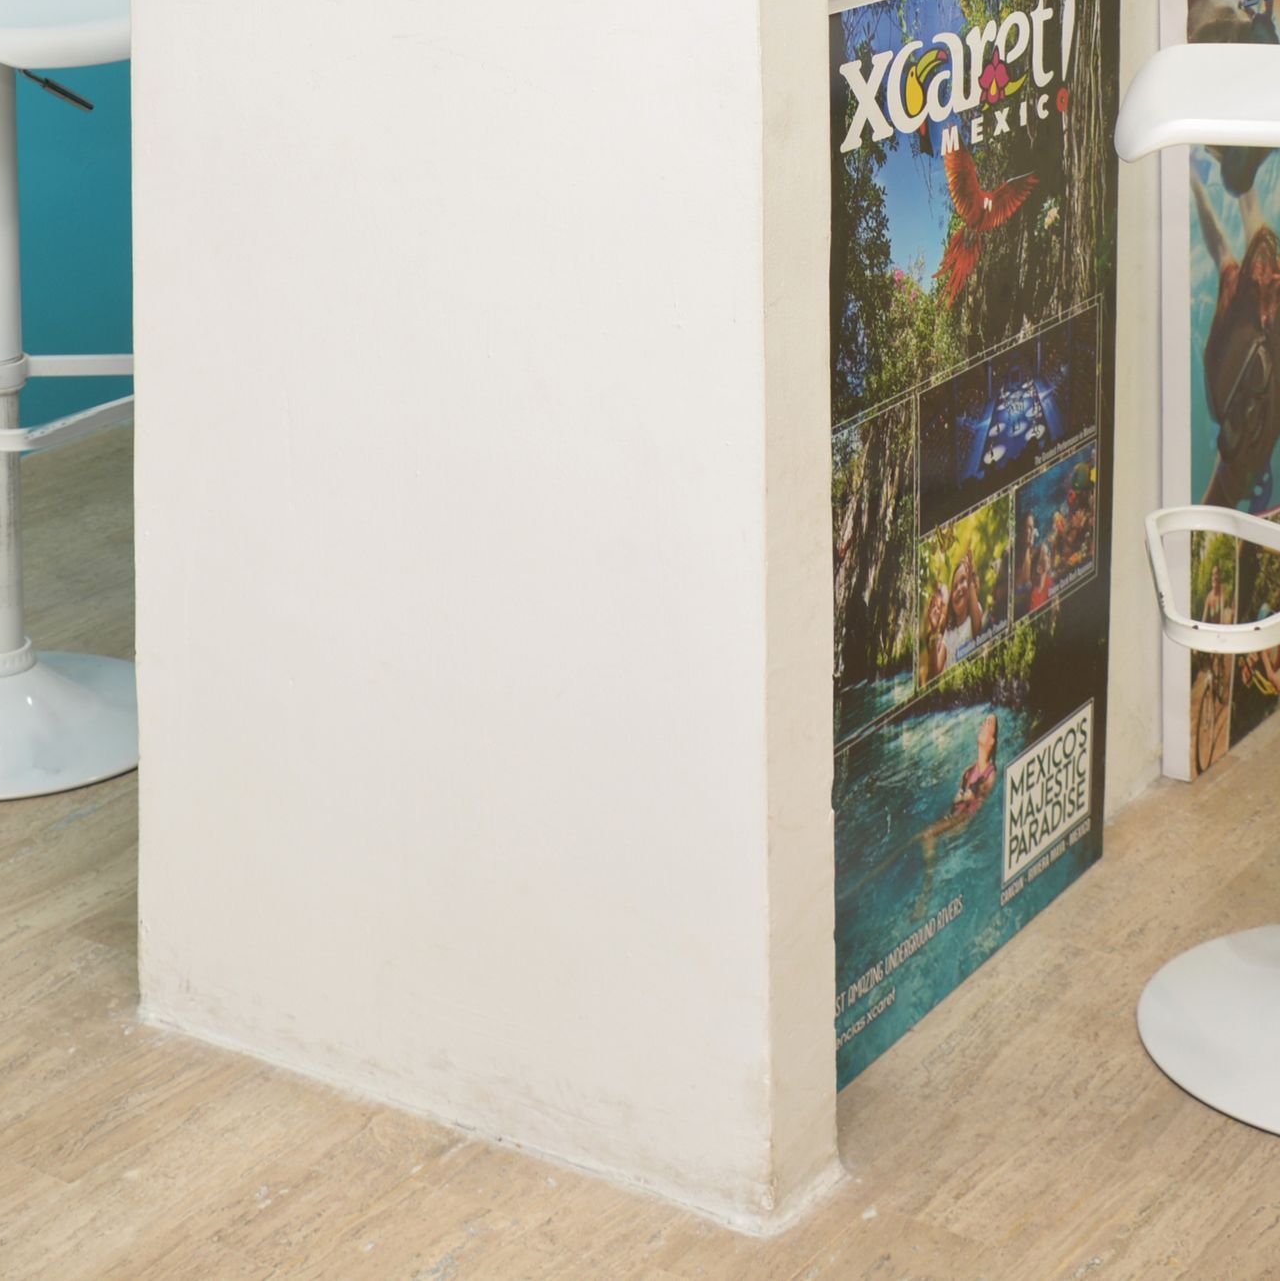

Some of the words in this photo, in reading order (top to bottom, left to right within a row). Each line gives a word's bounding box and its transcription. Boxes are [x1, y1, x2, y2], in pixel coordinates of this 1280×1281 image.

[1009, 716, 1088, 805] MEXICO'S
[1009, 748, 1087, 837] MAJESTIC
[1008, 777, 1086, 870] PARADISE
[847, 960, 884, 1008] AMAZING
[884, 917, 937, 976] UNDERGROUND
